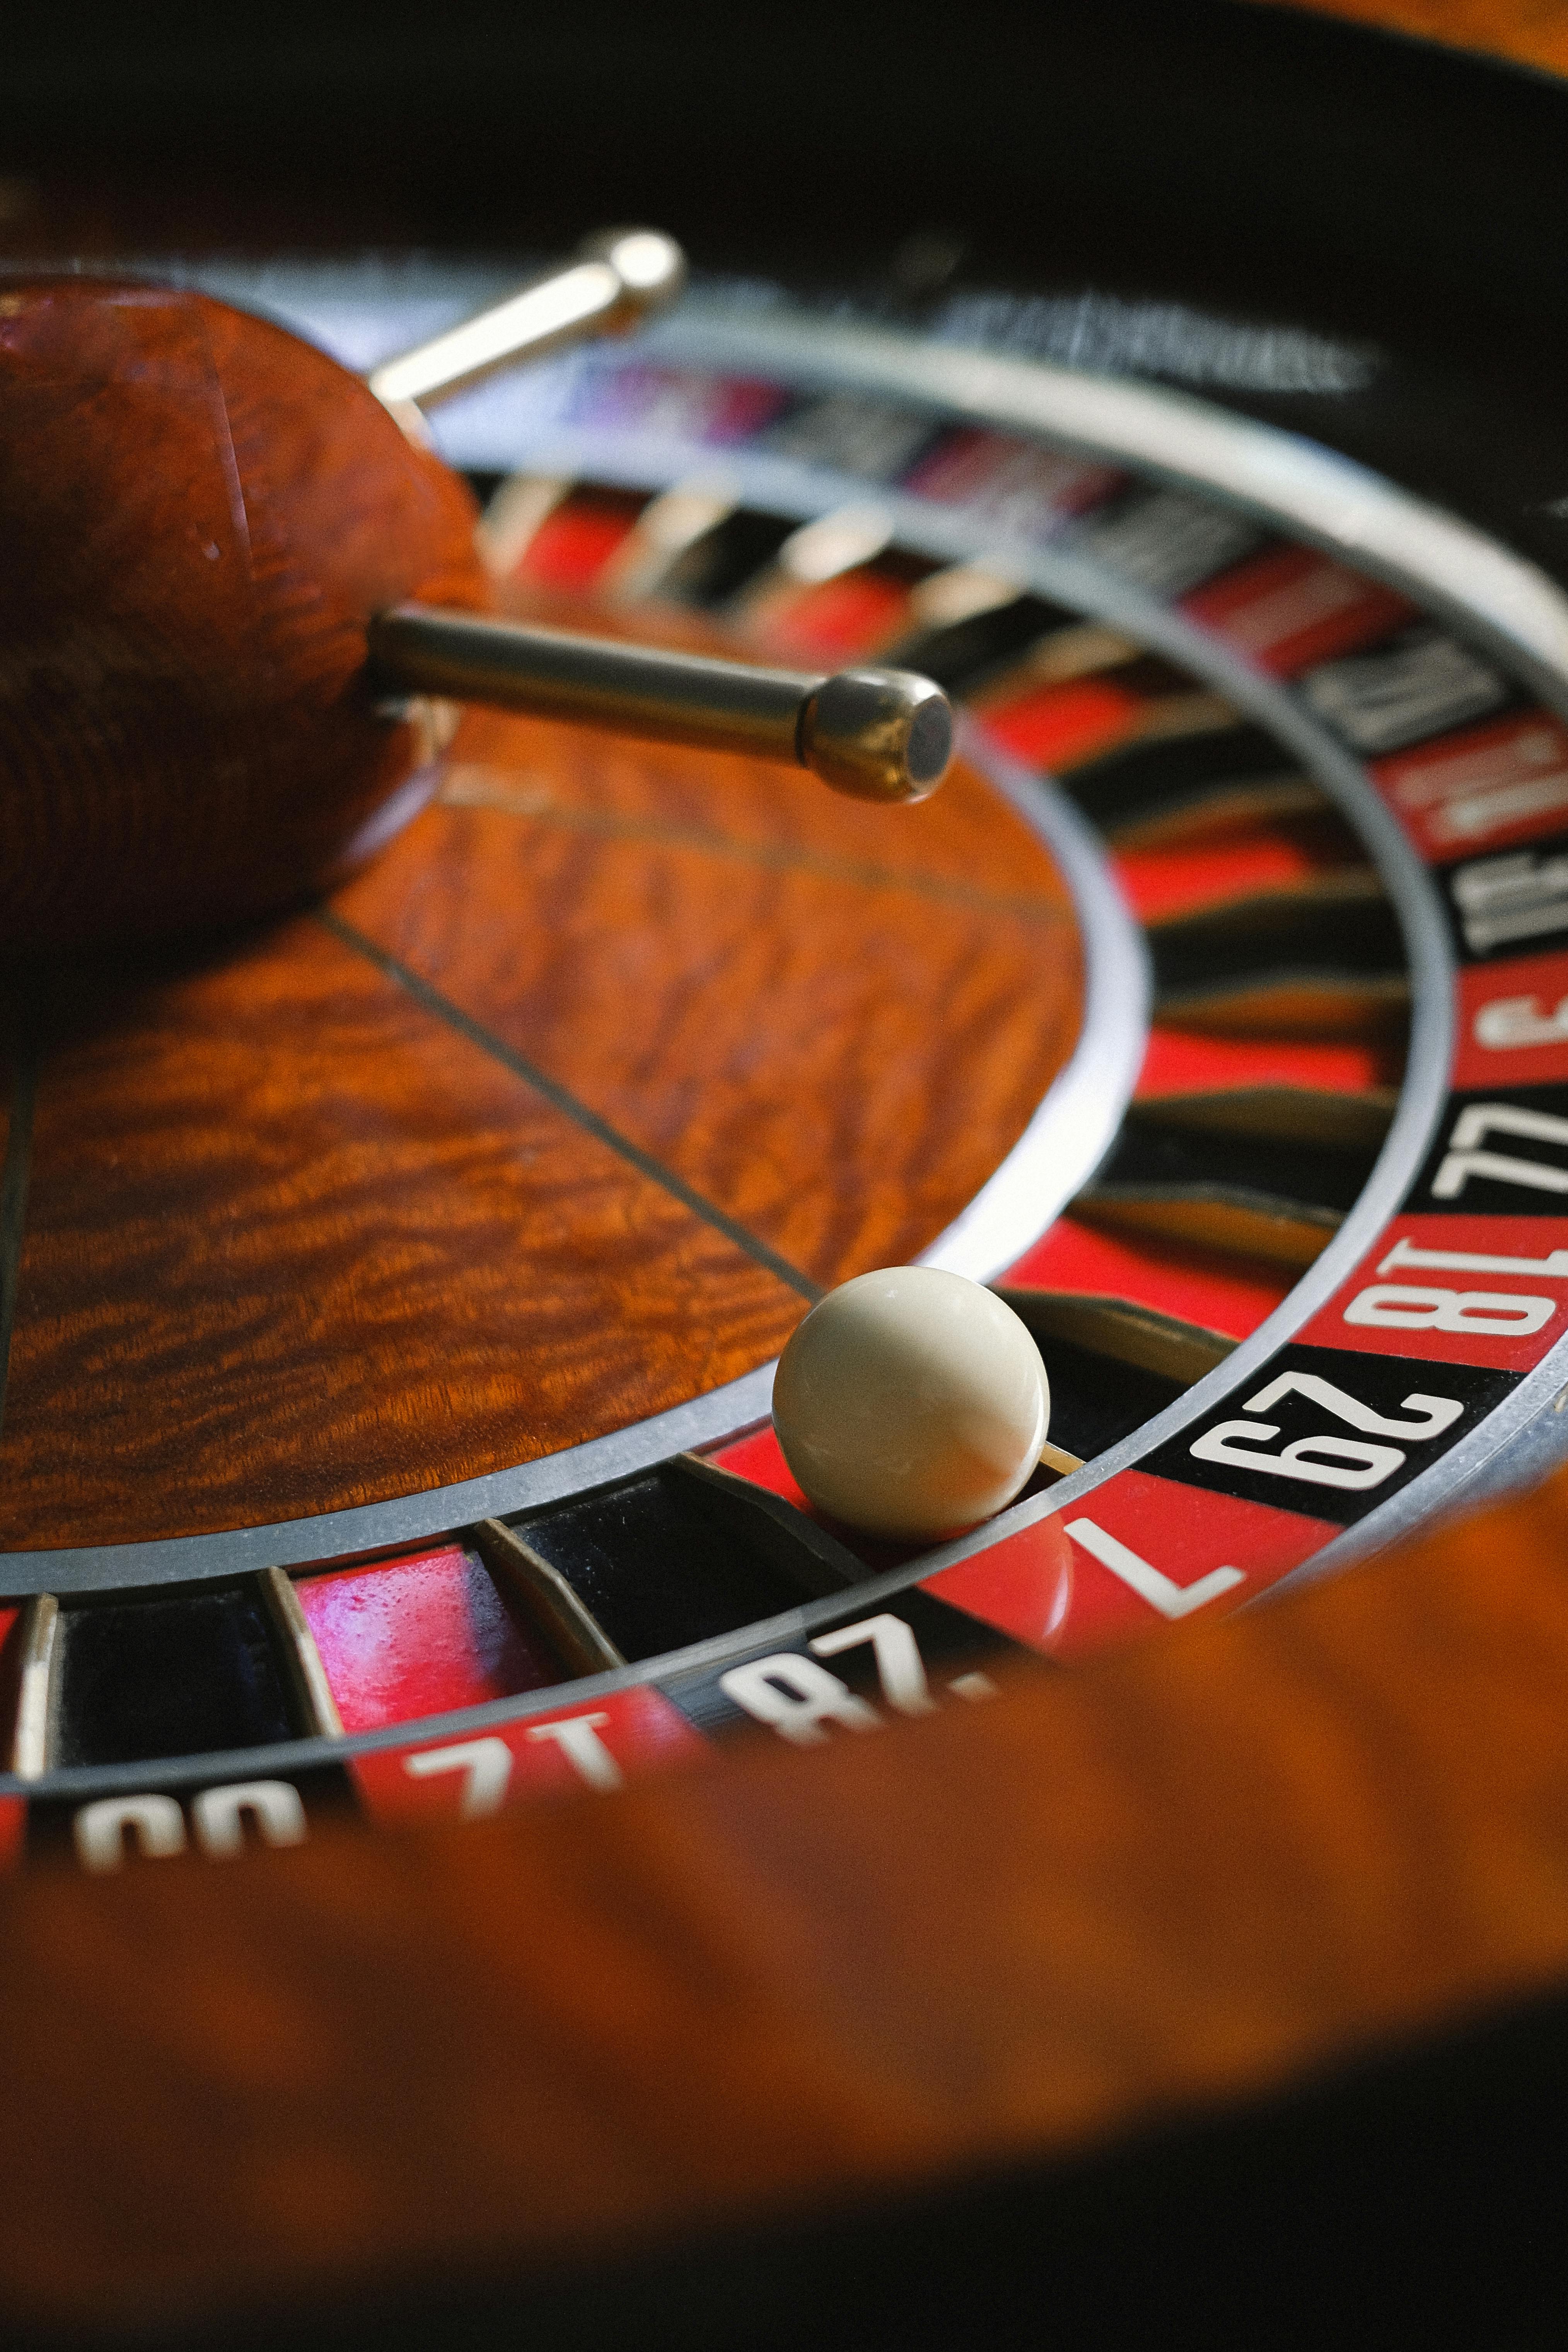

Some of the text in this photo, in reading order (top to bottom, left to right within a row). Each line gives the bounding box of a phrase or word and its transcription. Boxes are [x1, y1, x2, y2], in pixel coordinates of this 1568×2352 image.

[1343, 1237, 1568, 1336] 18
[1190, 1371, 1465, 1490] 29
[1063, 1517, 1247, 1619] 7
